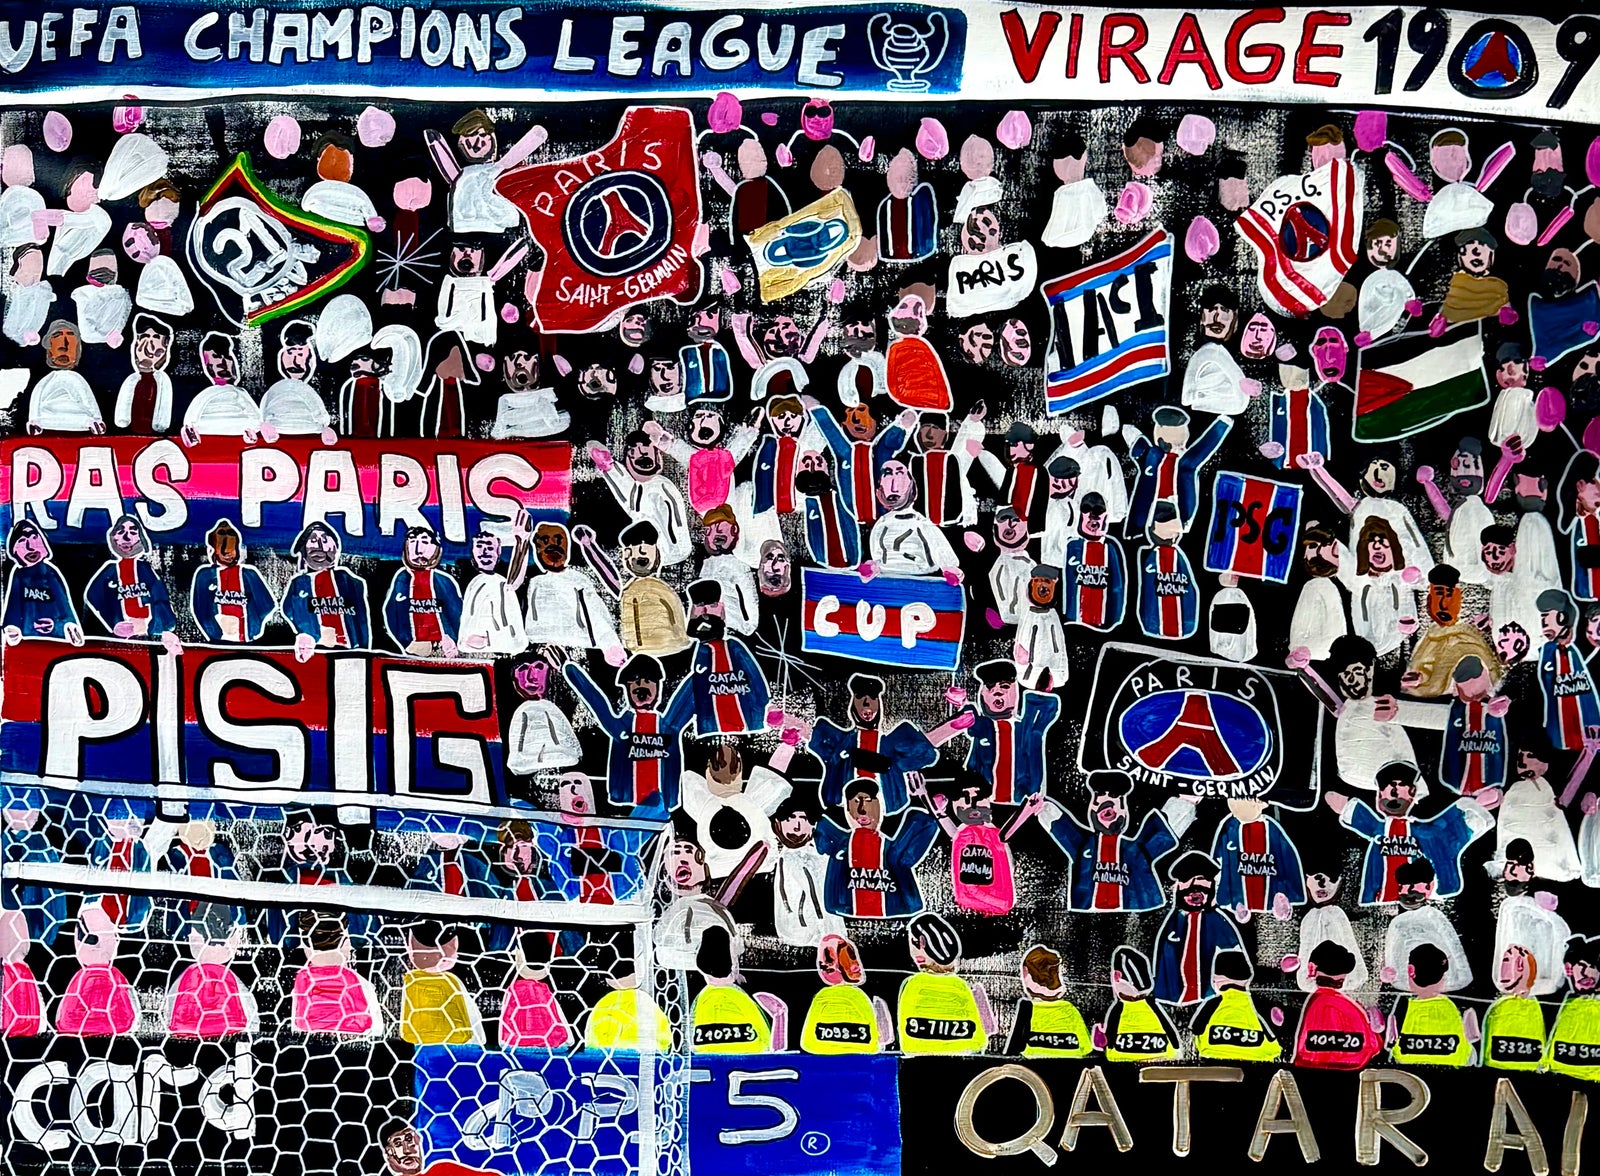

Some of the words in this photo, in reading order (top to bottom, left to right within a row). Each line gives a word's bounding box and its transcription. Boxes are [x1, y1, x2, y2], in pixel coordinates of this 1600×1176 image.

[0, 6, 141, 74] UEFA
[184, 6, 527, 71] CHAMPIONS
[553, 15, 846, 87] LEAGUE
[1000, 7, 1353, 90] VIRAGE
[533, 140, 663, 217] PARIS
[956, 254, 1025, 294] PARIS
[11, 439, 191, 531] RAS
[240, 445, 541, 542] PARIS
[1214, 499, 1293, 556] PSG
[813, 595, 938, 650] CUP
[709, 670, 746, 682] QATAR
[1131, 666, 1259, 700] PARIS
[851, 868, 892, 881] QATAR
[954, 1063, 1431, 1168] QATAR
